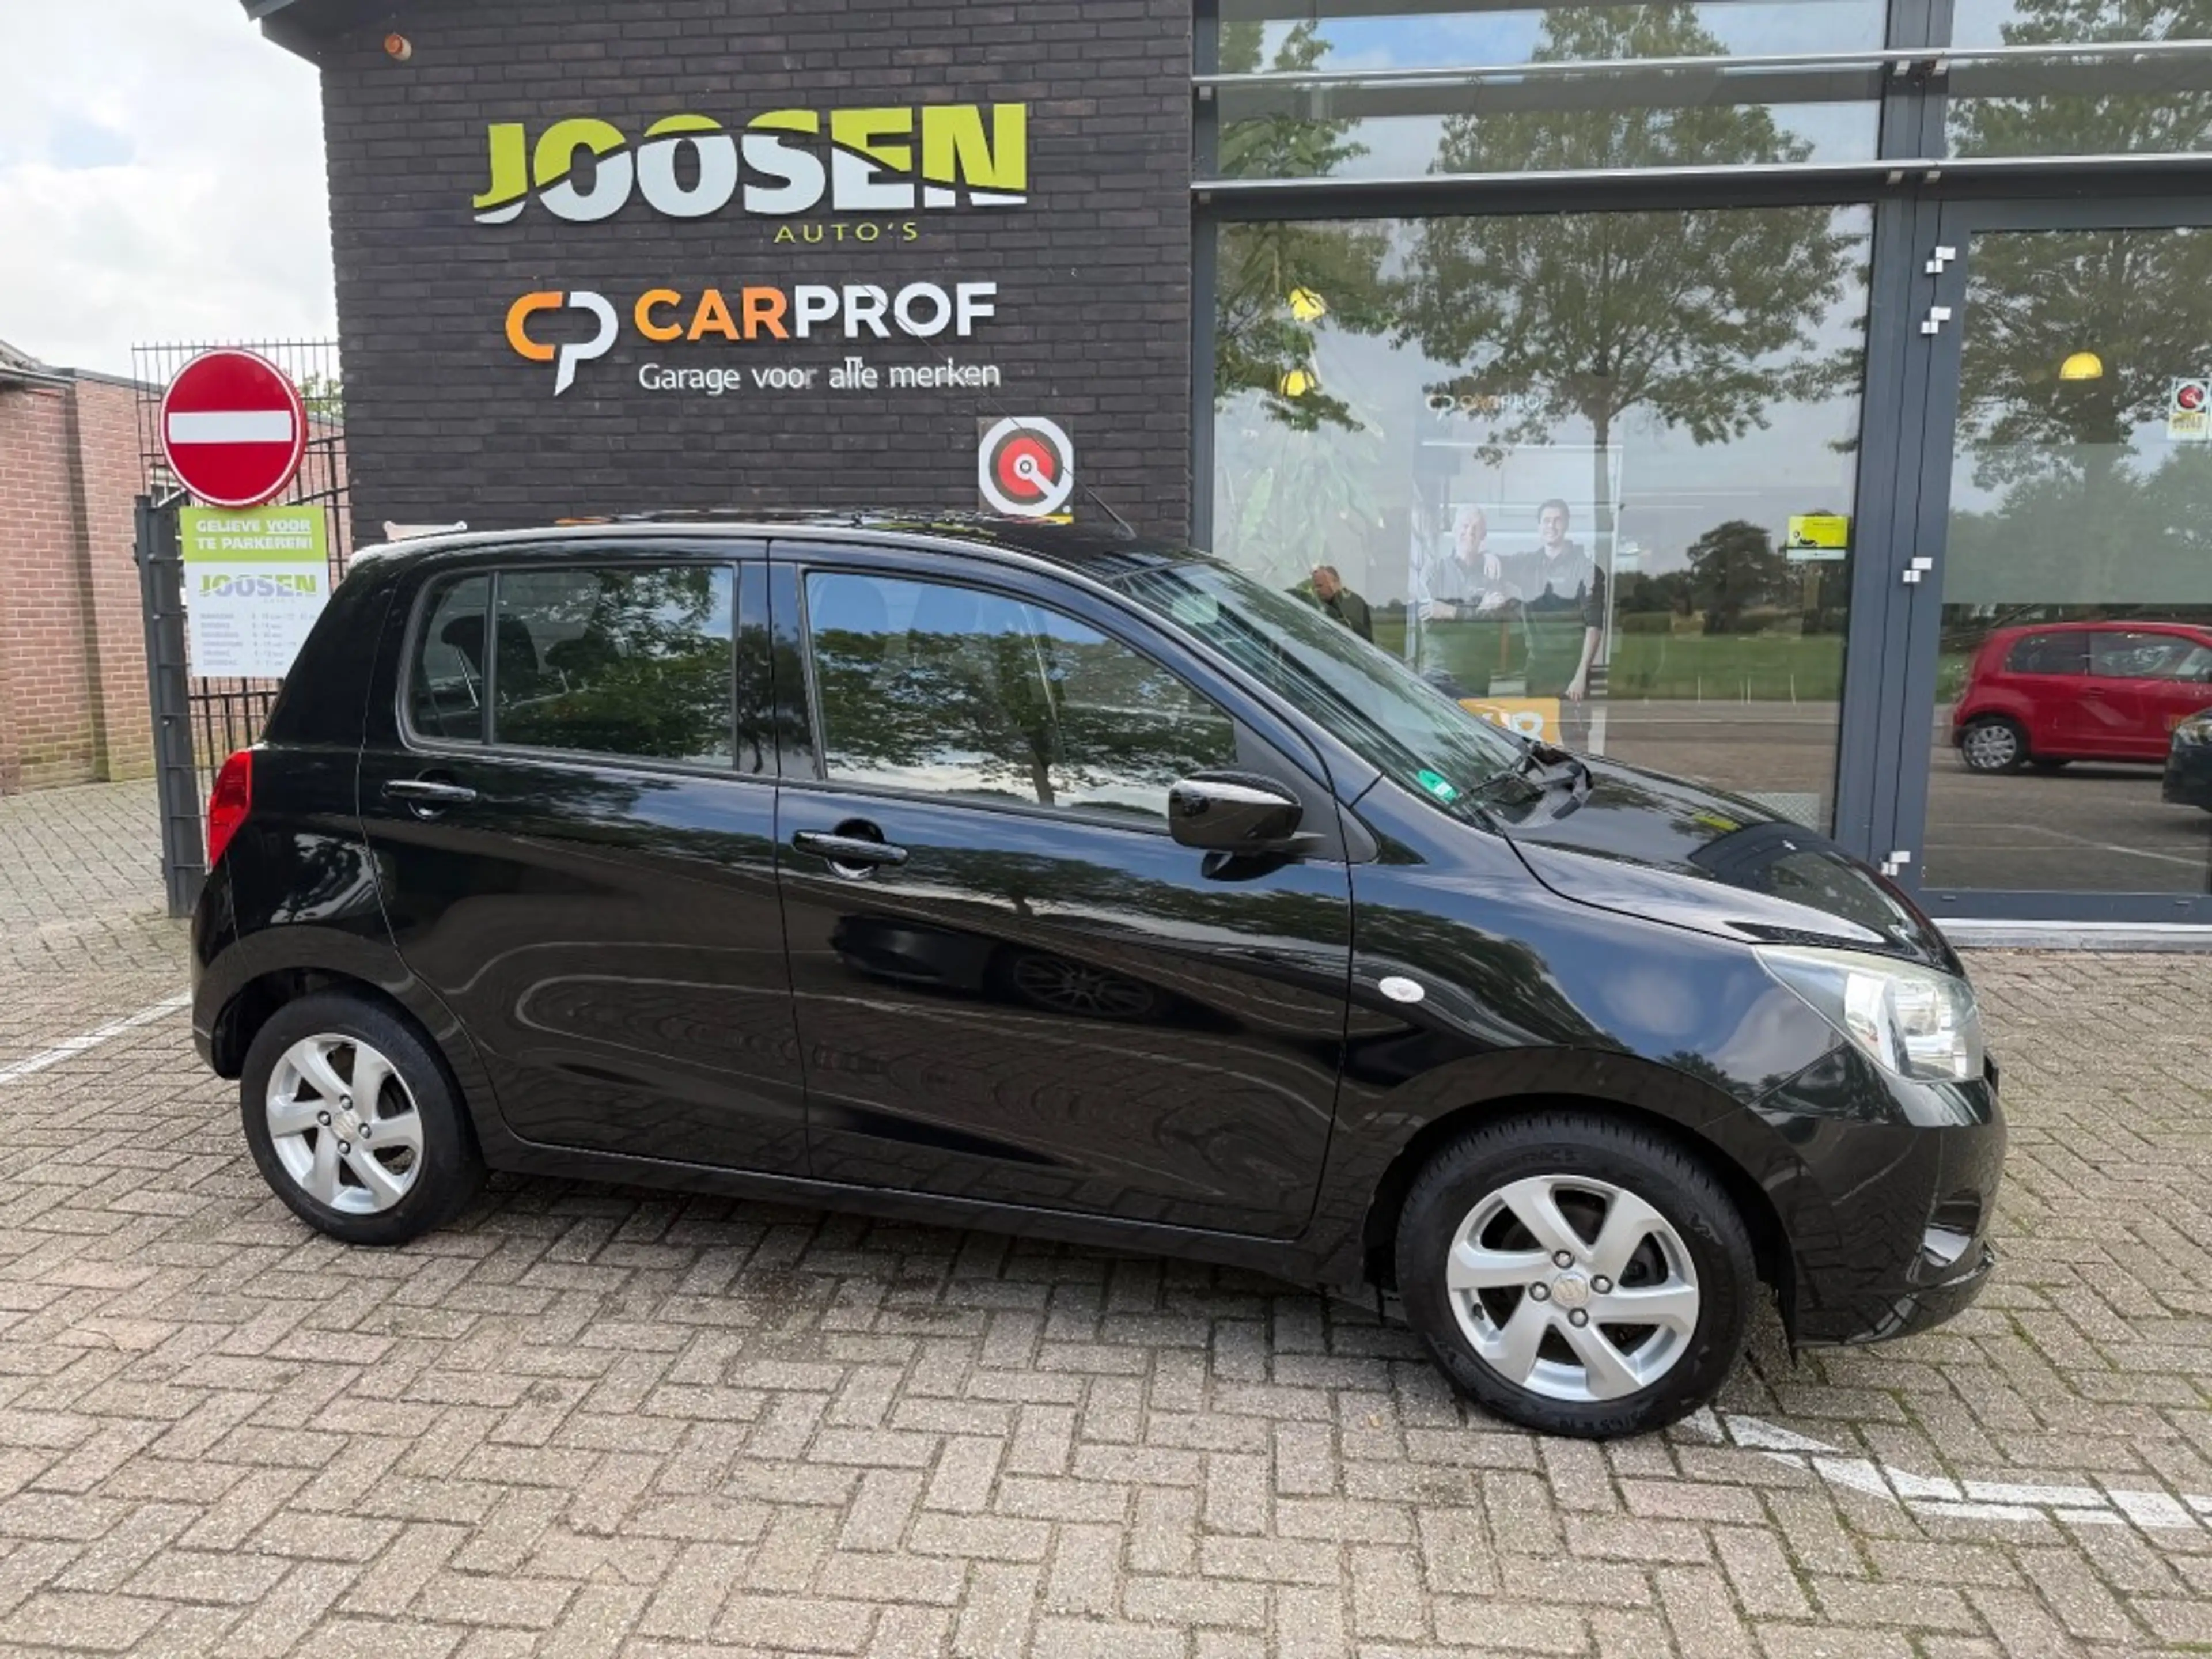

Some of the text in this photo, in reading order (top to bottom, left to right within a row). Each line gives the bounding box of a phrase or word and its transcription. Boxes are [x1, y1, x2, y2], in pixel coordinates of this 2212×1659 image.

[472, 103, 1027, 223] JOOSEN
[774, 222, 918, 243] AUTO'S
[634, 282, 997, 341] CARPROF
[639, 356, 1001, 395] Garage voor alle merken
[196, 519, 261, 533] GELIEVE
[194, 537, 217, 550] TE
[199, 574, 316, 597] JOOSEN
